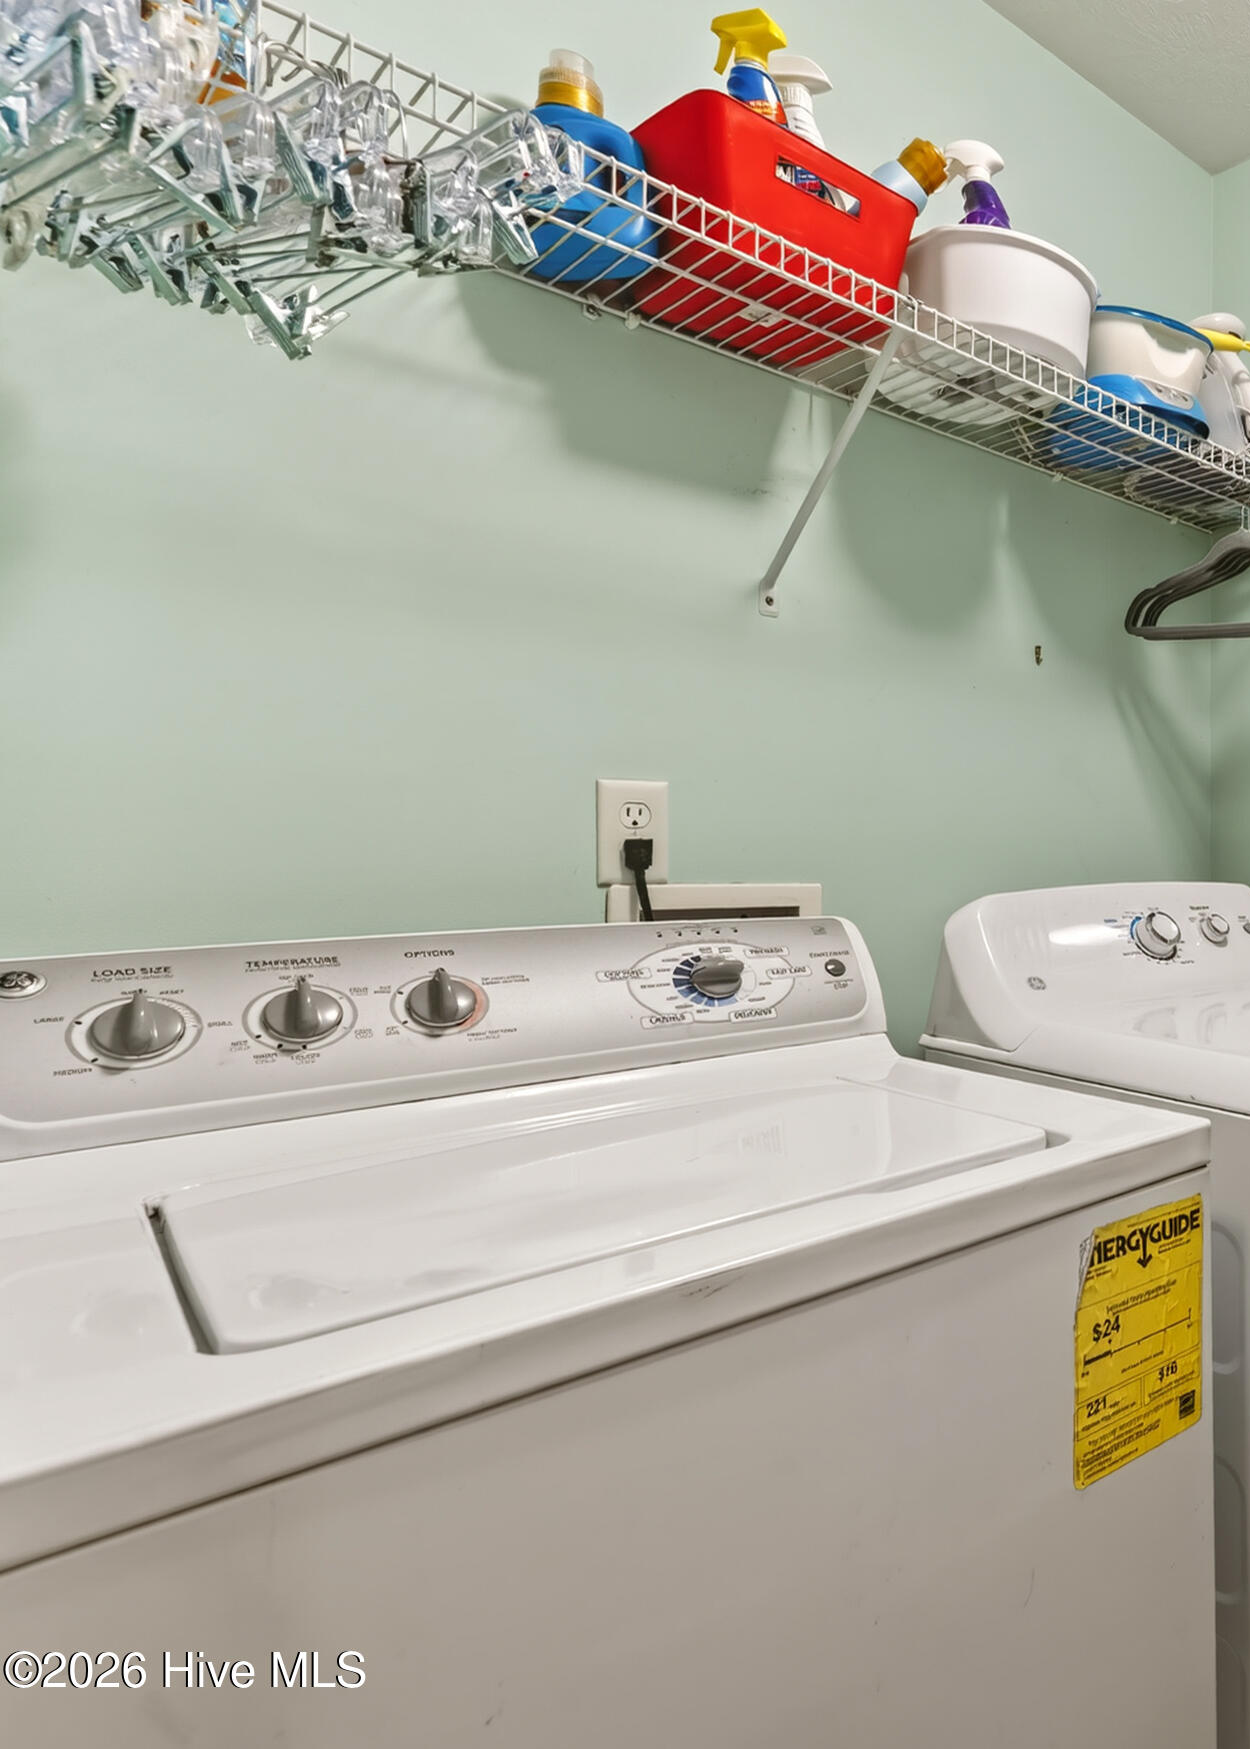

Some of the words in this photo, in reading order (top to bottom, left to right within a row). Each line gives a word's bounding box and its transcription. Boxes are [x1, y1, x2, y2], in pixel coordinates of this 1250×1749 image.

[92, 967, 137, 978] LOAD
[140, 966, 172, 976] SIZE
[245, 956, 339, 969] TEMPERATURE
[1088, 1208, 1200, 1268] NERGYGUIDE
[1092, 1315, 1121, 1343] $24
[1086, 1396, 1108, 1418] 221
